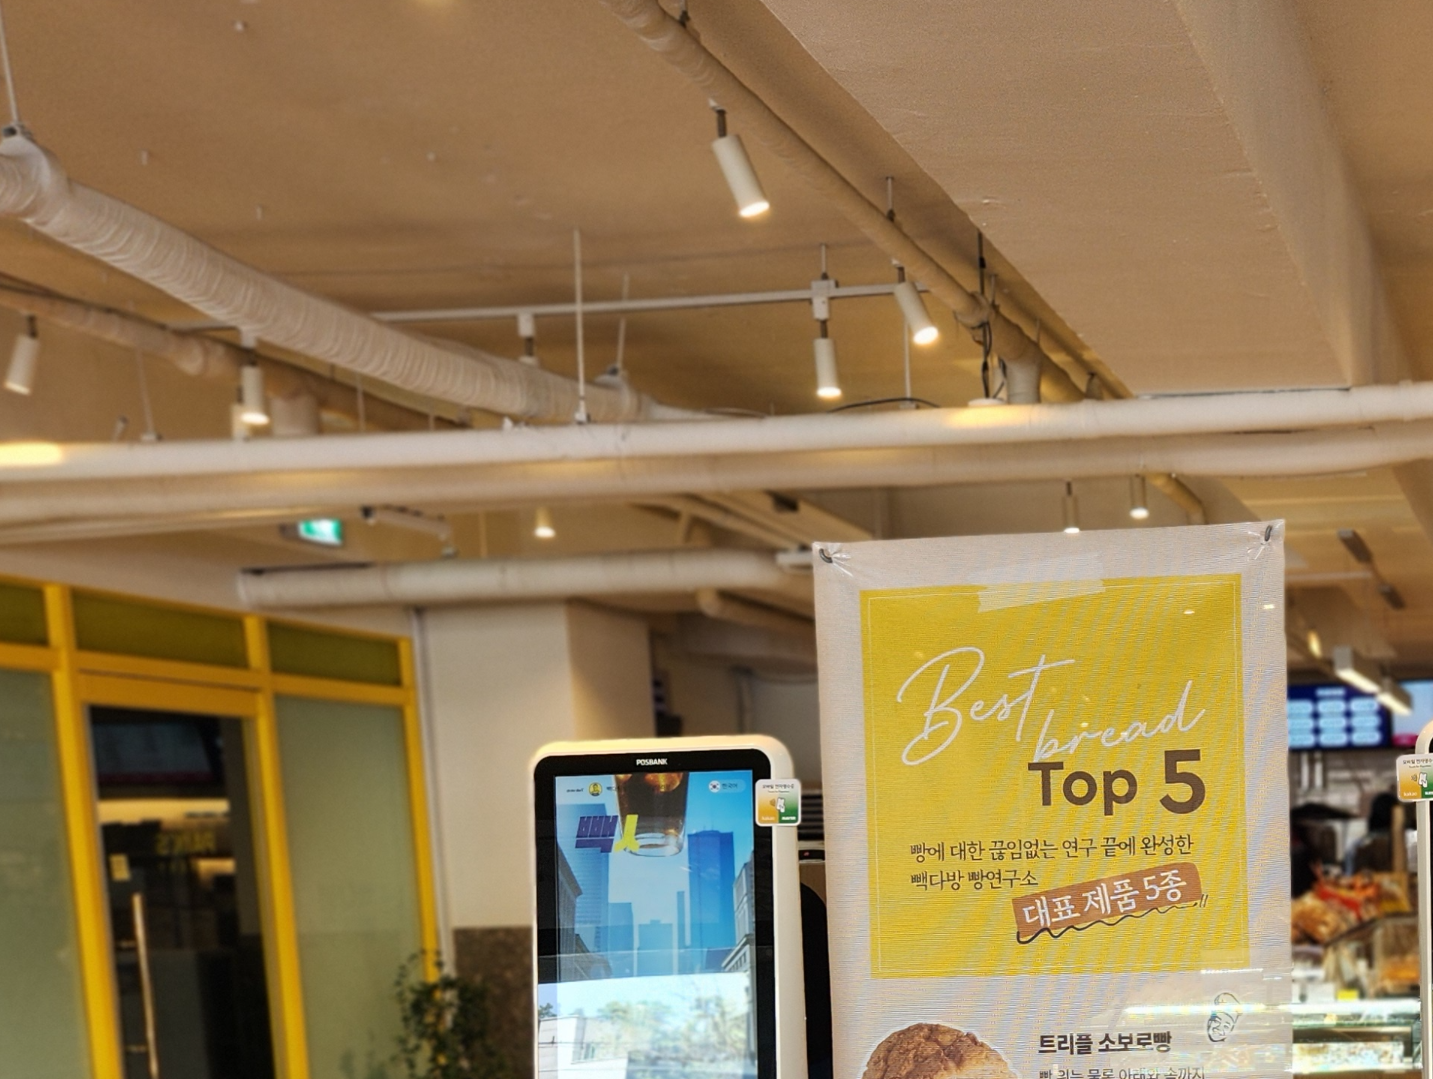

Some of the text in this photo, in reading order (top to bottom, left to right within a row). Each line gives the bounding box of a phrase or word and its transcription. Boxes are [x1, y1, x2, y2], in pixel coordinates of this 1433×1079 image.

[896, 646, 1076, 767] Best
[1033, 680, 1206, 763] bread
[636, 758, 668, 766] POSBANK
[1027, 749, 1206, 816] Top 5
[910, 835, 1194, 861] 빵에 대한 끊임없는 연구 끝에 완성한
[910, 869, 1039, 891] 빽다방 빵연구소
[1022, 869, 1188, 929] 대표 제품 5종
[1037, 1031, 1172, 1056] 트리플 소보로빵
